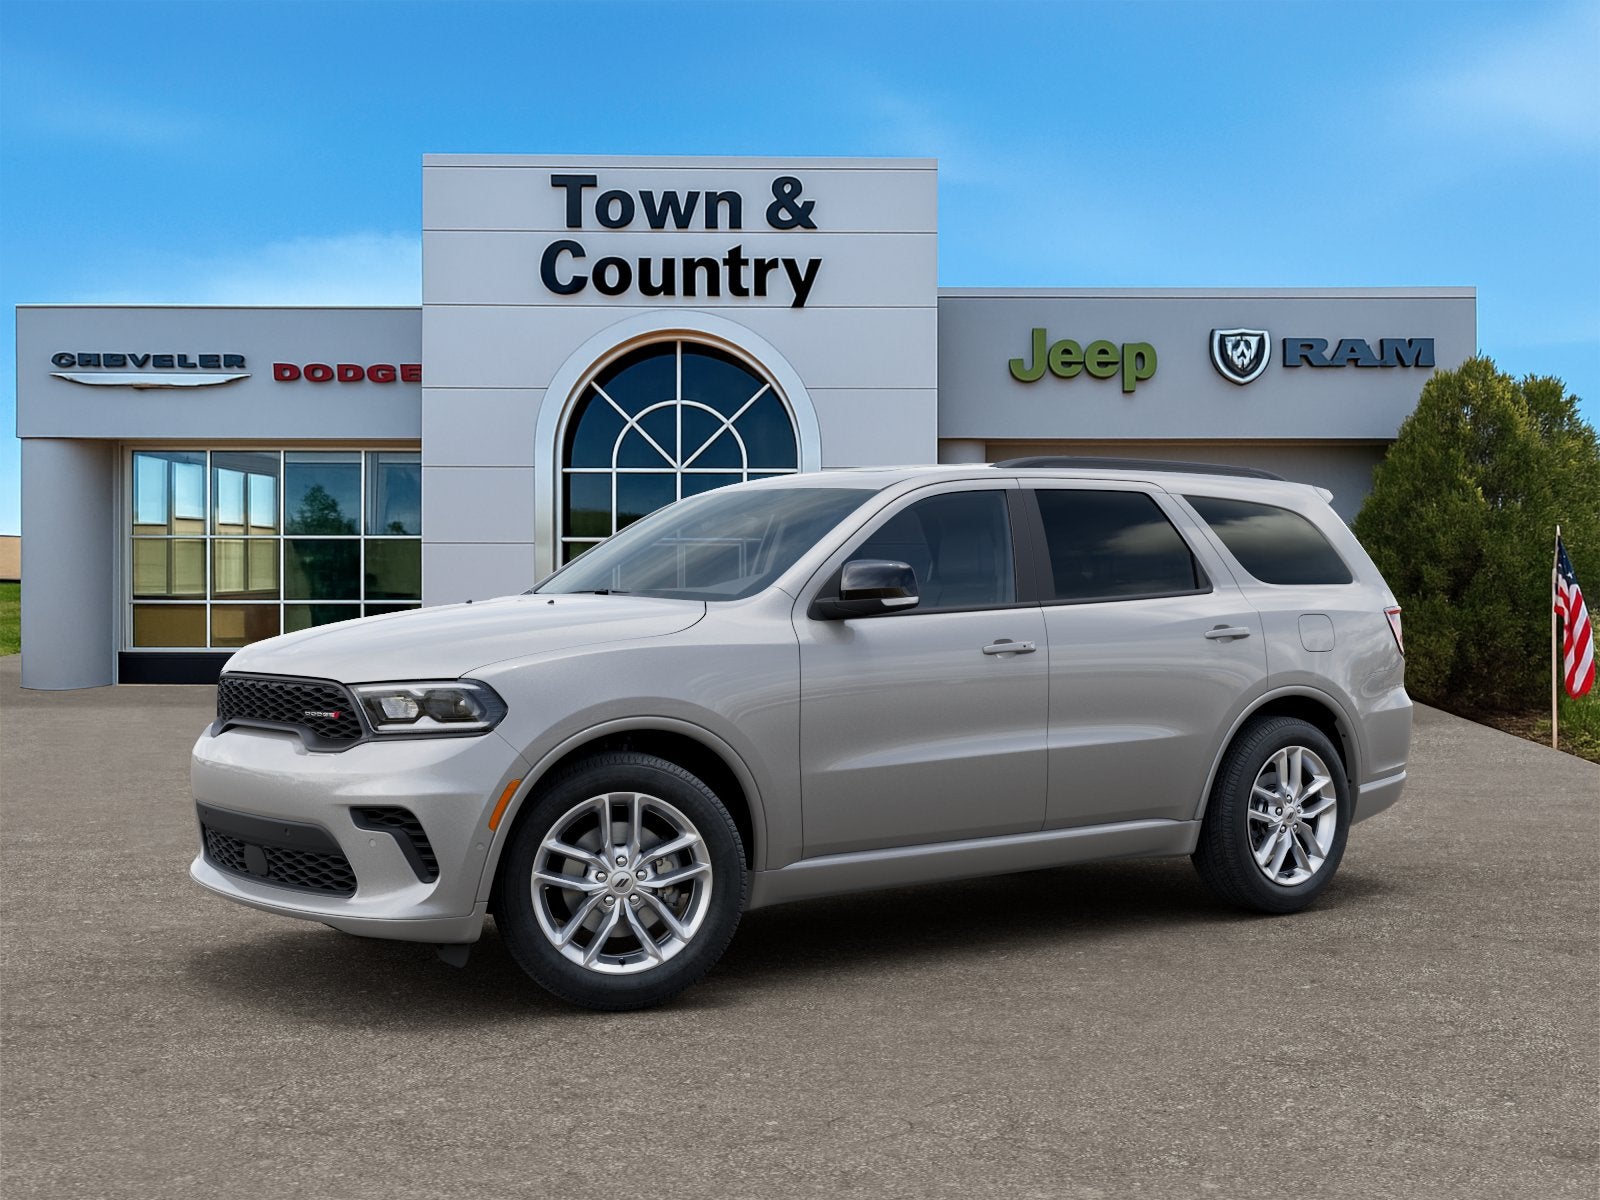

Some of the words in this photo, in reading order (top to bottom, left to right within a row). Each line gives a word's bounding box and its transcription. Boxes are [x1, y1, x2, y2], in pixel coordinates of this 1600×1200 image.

[551, 174, 743, 230] Town
[765, 175, 818, 230] &
[540, 239, 823, 308] Country
[273, 363, 422, 383] DODGE
[1008, 327, 1157, 393] Jeep
[1282, 337, 1435, 368] RAM
